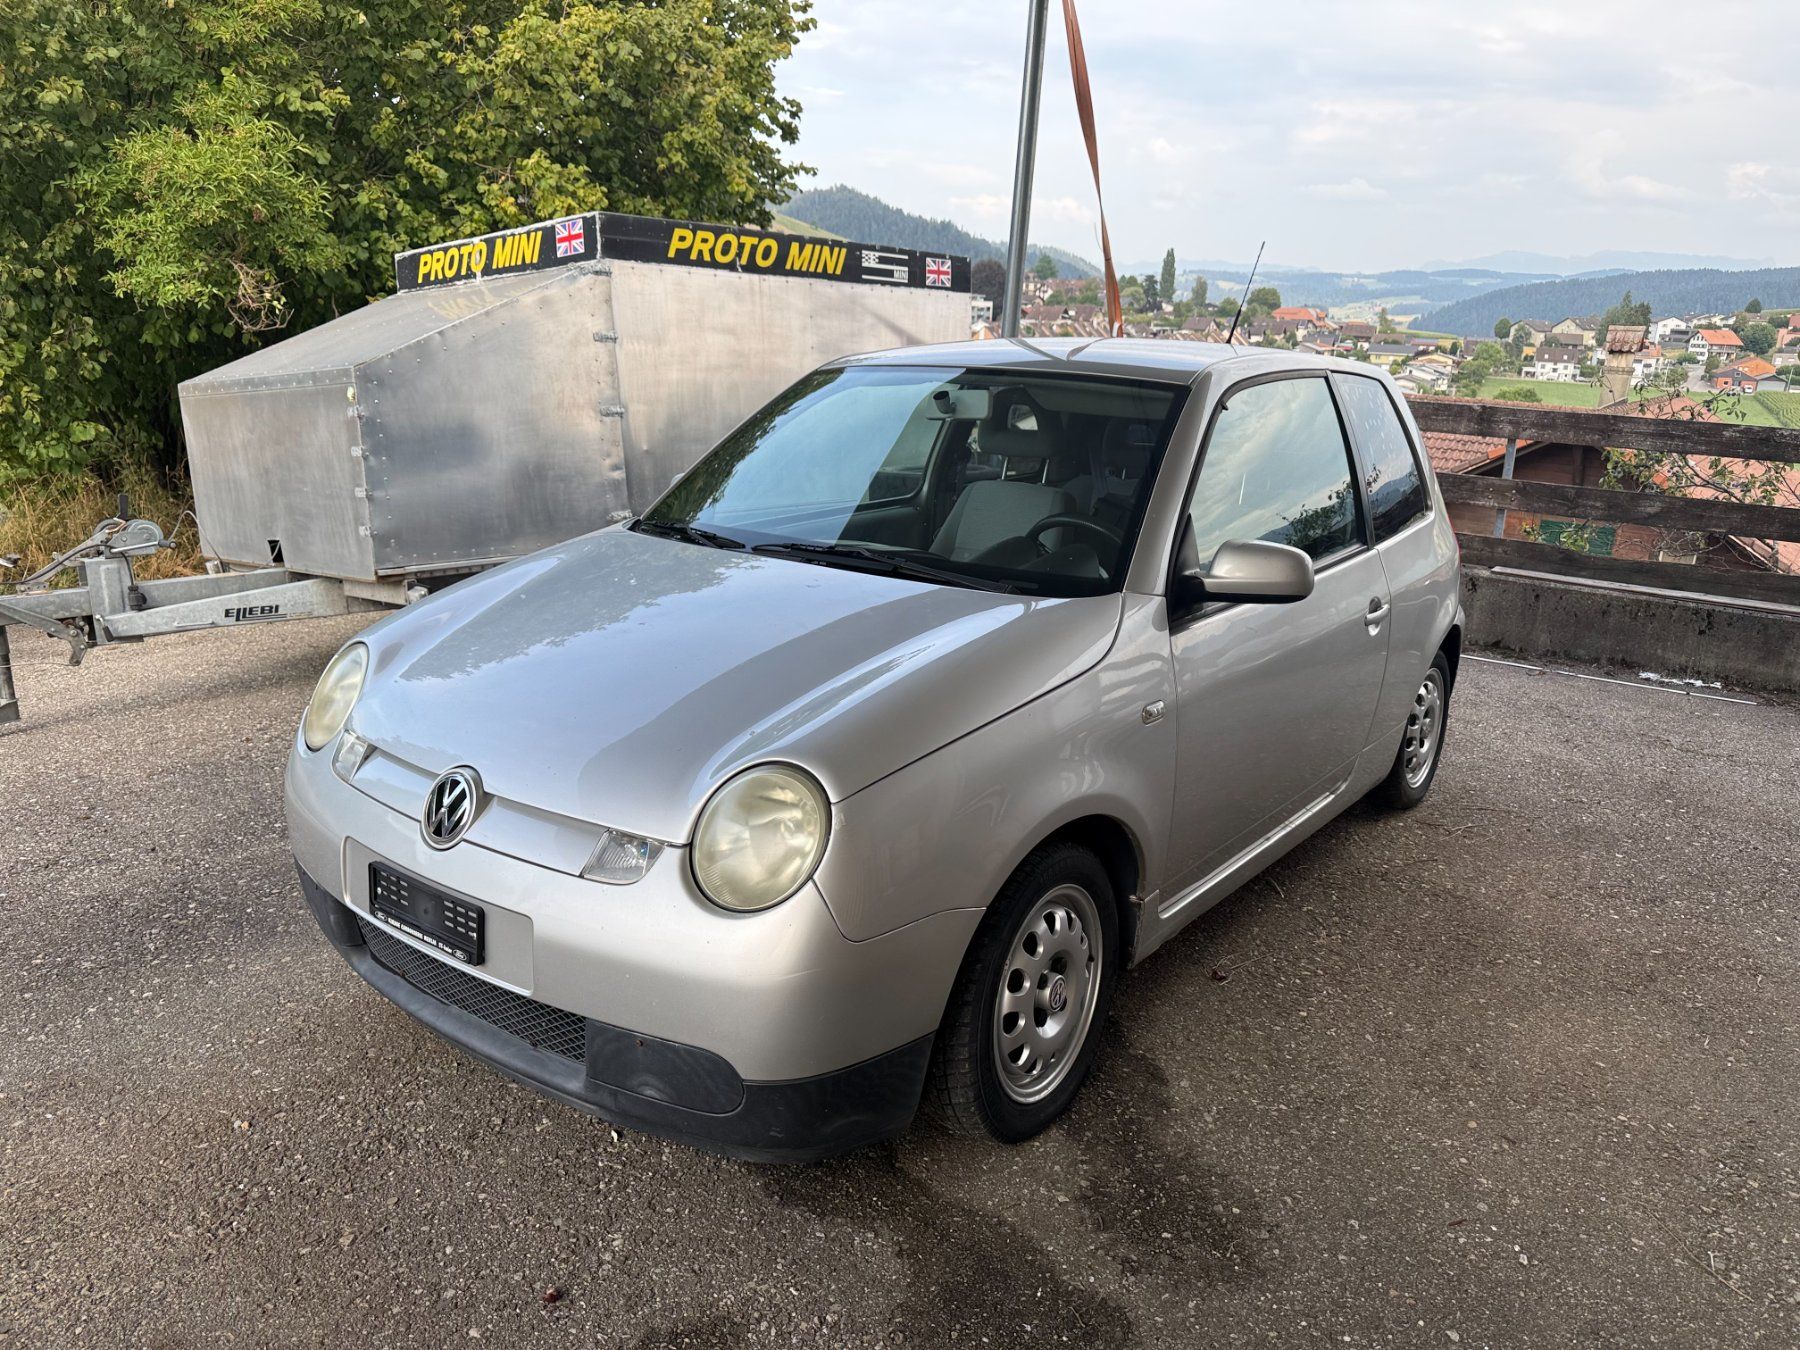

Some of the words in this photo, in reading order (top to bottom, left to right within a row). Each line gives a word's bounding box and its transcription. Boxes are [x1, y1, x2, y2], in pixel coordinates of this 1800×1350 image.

[417, 241, 487, 284] PROTO
[492, 230, 543, 269] MINI
[667, 228, 778, 268] PROTO
[785, 241, 847, 275] MINI
[224, 604, 280, 622] ELLEBI
